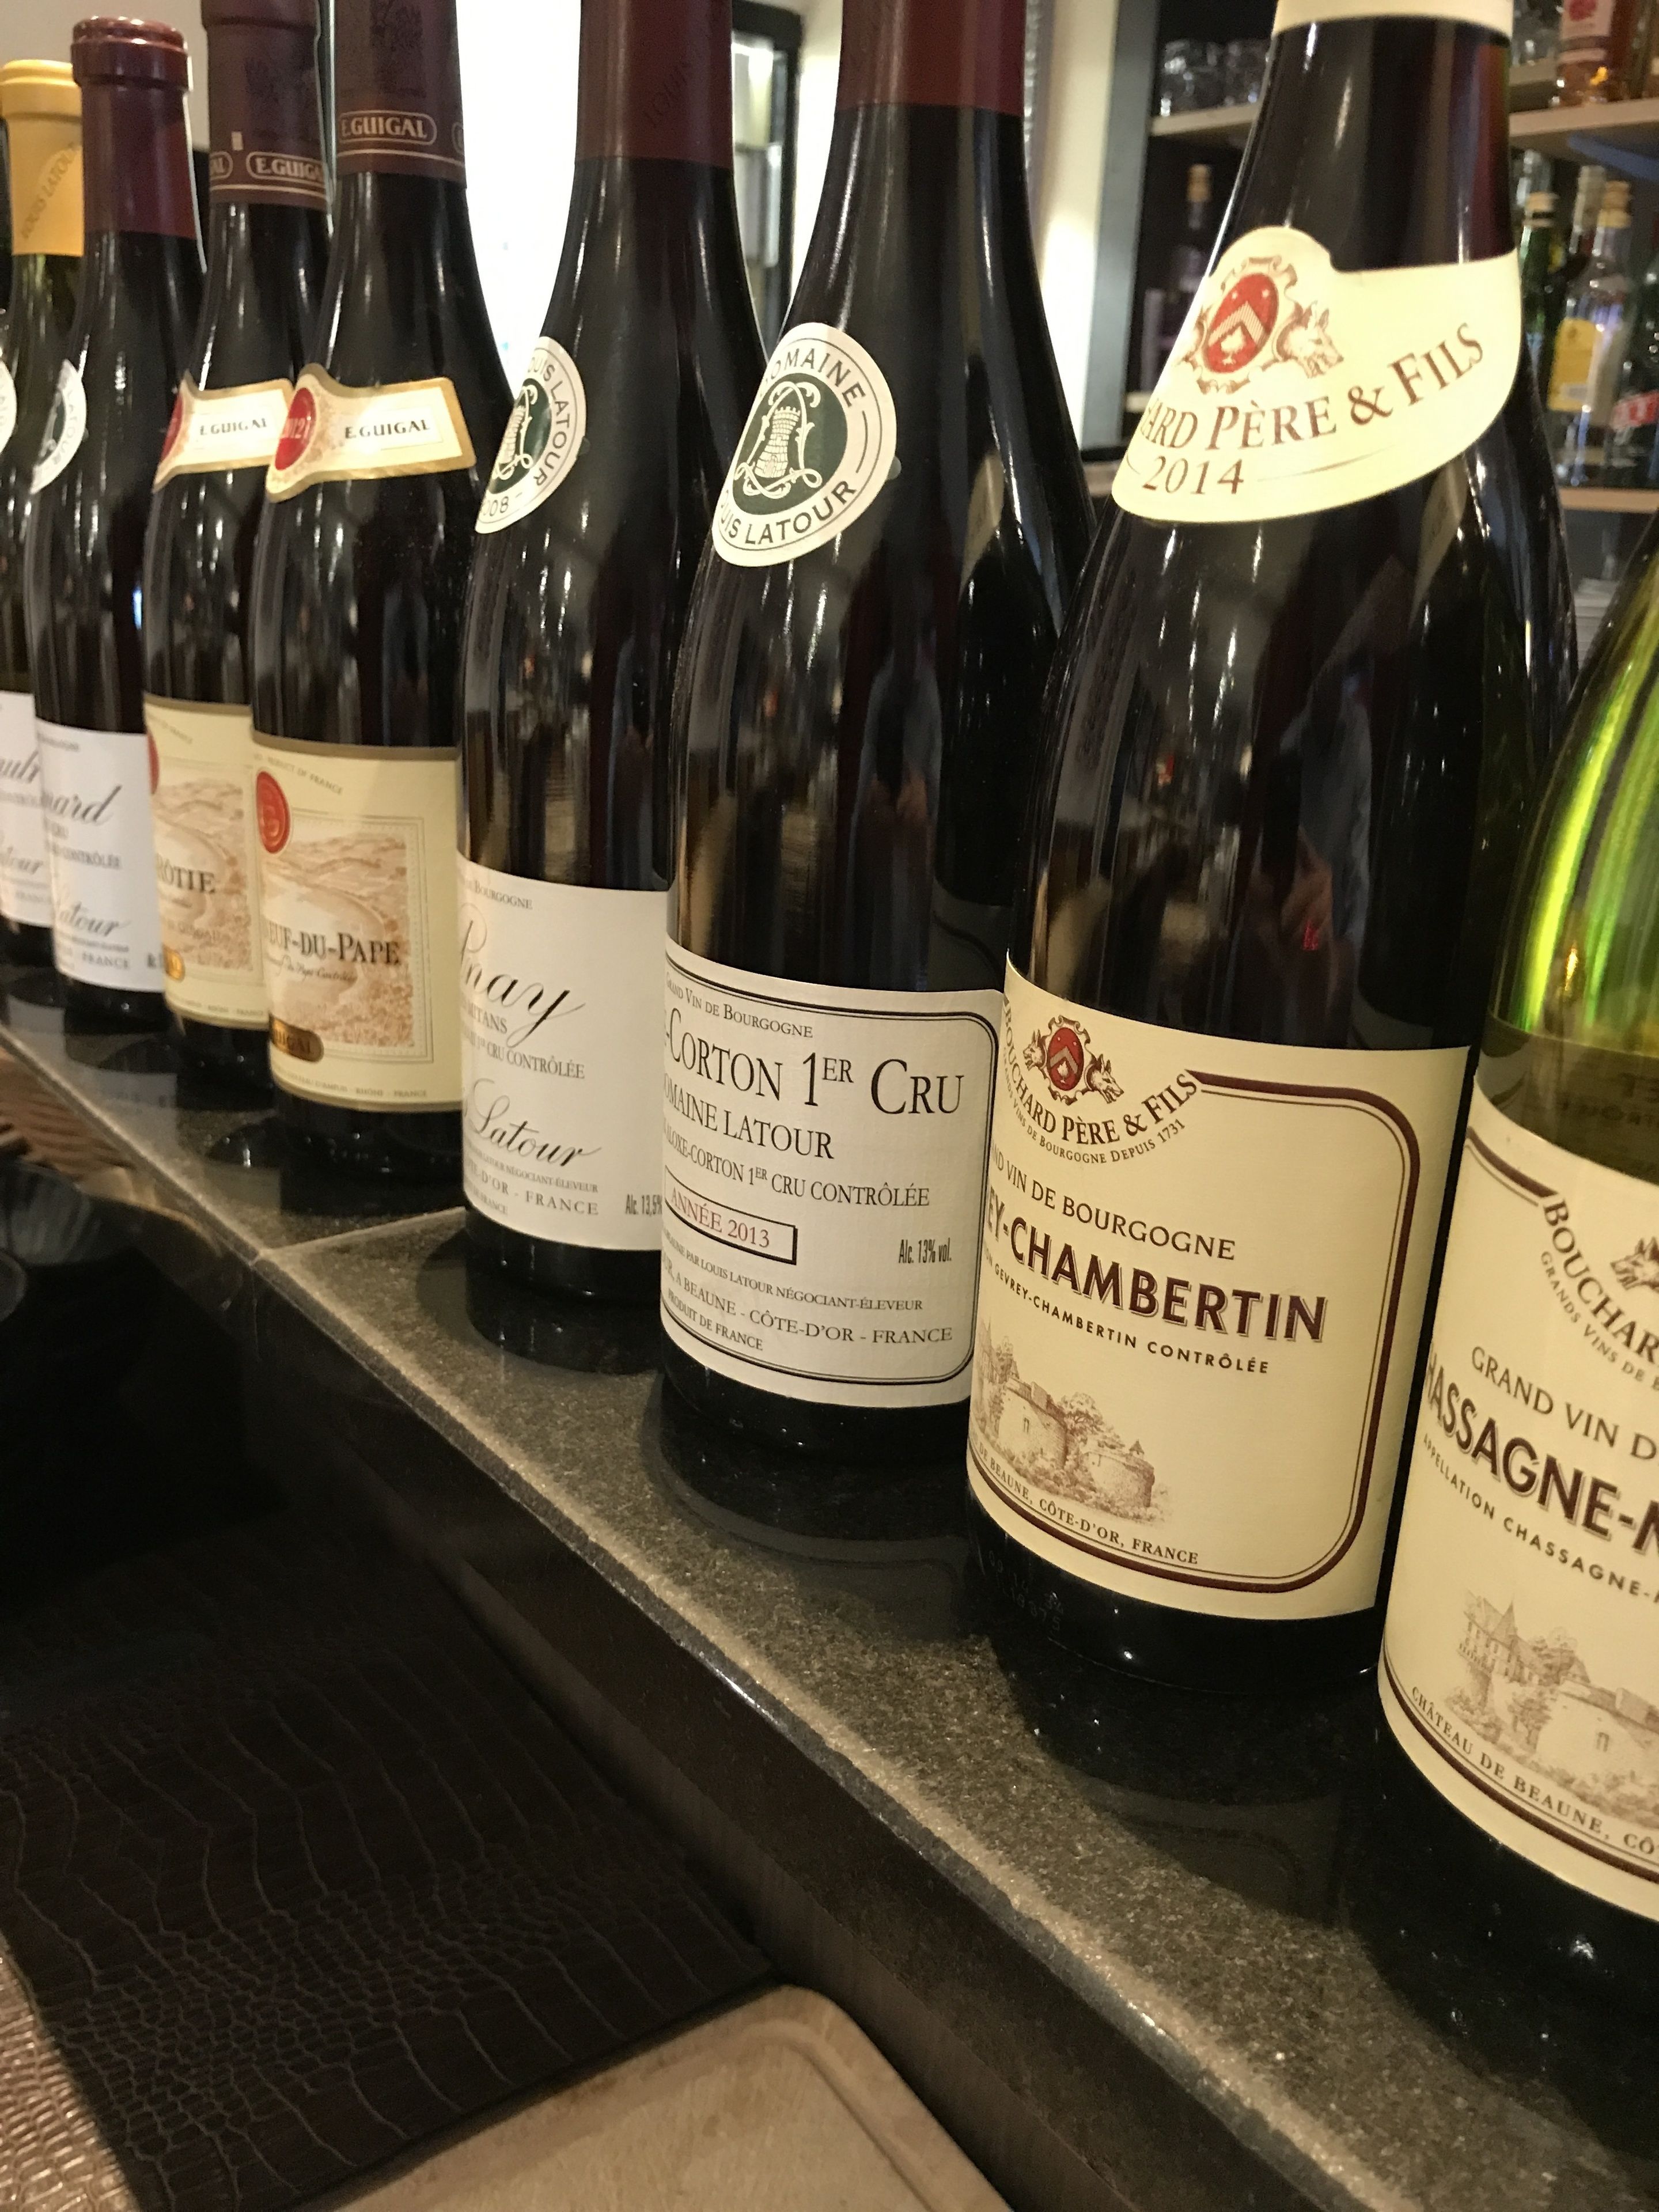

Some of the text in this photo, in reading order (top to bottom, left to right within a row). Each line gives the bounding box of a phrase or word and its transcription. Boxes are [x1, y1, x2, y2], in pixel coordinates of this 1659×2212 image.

[770, 348, 866, 408] OMAINE
[1205, 400, 1337, 450] PÈRE
[1347, 385, 1393, 426] &
[1389, 323, 1483, 406] FILS
[533, 381, 569, 486] LATOUR
[745, 480, 857, 545] LATOUR
[1142, 455, 1244, 495] 2014
[475, 880, 533, 910] BOURGOGNE
[268, 921, 402, 967] EUF-DU-PAPE
[685, 987, 702, 1009] VIN
[705, 1001, 720, 1017] DE
[723, 1003, 814, 1039] BOURGOGNE
[487, 1041, 505, 1062] CRU
[507, 1049, 585, 1080] CONTRÔLÉE
[666, 1007, 783, 1101] -CORTON
[870, 1058, 965, 1115] CRU
[1005, 1008, 1198, 1146] BOUCHARD PÈRE & FILS
[469, 1078, 602, 1166] Latour
[664, 1073, 835, 1160] OMAINE LATOUR
[1014, 1098, 1027, 1127] VINS
[1027, 1126, 1037, 1141] DE
[1039, 1135, 1107, 1165] BOURGOGNE
[1111, 1138, 1156, 1163] DEPUIS
[1157, 1118, 1186, 1143] 1731
[525, 1190, 599, 1215] FRANCE
[671, 1187, 770, 1248] ANNÉE 2013
[772, 1173, 806, 1198] CRU
[810, 1181, 930, 1207] CONTRÔLÉE
[1007, 1160, 1028, 1194] VIN
[1031, 1179, 1056, 1210] DE
[1063, 1195, 1236, 1260] BOURGOGNE
[686, 1249, 700, 1267] PAR
[701, 1258, 728, 1279] LOUIS
[730, 1271, 774, 1295] LATOUR
[899, 1237, 952, 1264] Alc. 13% vol.
[987, 1185, 1328, 1343] EY-CHAMBERTIN
[1543, 1196, 1659, 1365] BOUCHAR
[668, 1287, 764, 1351] PRODUIT DE FRANCE
[684, 1277, 737, 1316] BEAUNE
[749, 1309, 855, 1342] CÔTE-D'OR
[872, 1326, 953, 1344] FRANCE
[994, 1263, 1137, 1349] GEVREY-CHAMBERTIN
[1147, 1340, 1270, 1374] CONTRÔLÉE
[1540, 1250, 1646, 1382] GRANDS VINS DE
[1472, 1346, 1659, 1461] GRAND VIN D
[990, 1456, 1033, 1505] BEAUNE,
[1039, 1497, 1124, 1548] CÔTE-D'OR,
[1131, 1537, 1199, 1566] FRANCE
[1423, 1433, 1495, 1520] APPELLATION
[1411, 1686, 1474, 1755] CHÂTEAU
[1479, 1751, 1505, 1780] DE
[1513, 1774, 1611, 1840] BEAUNE,
